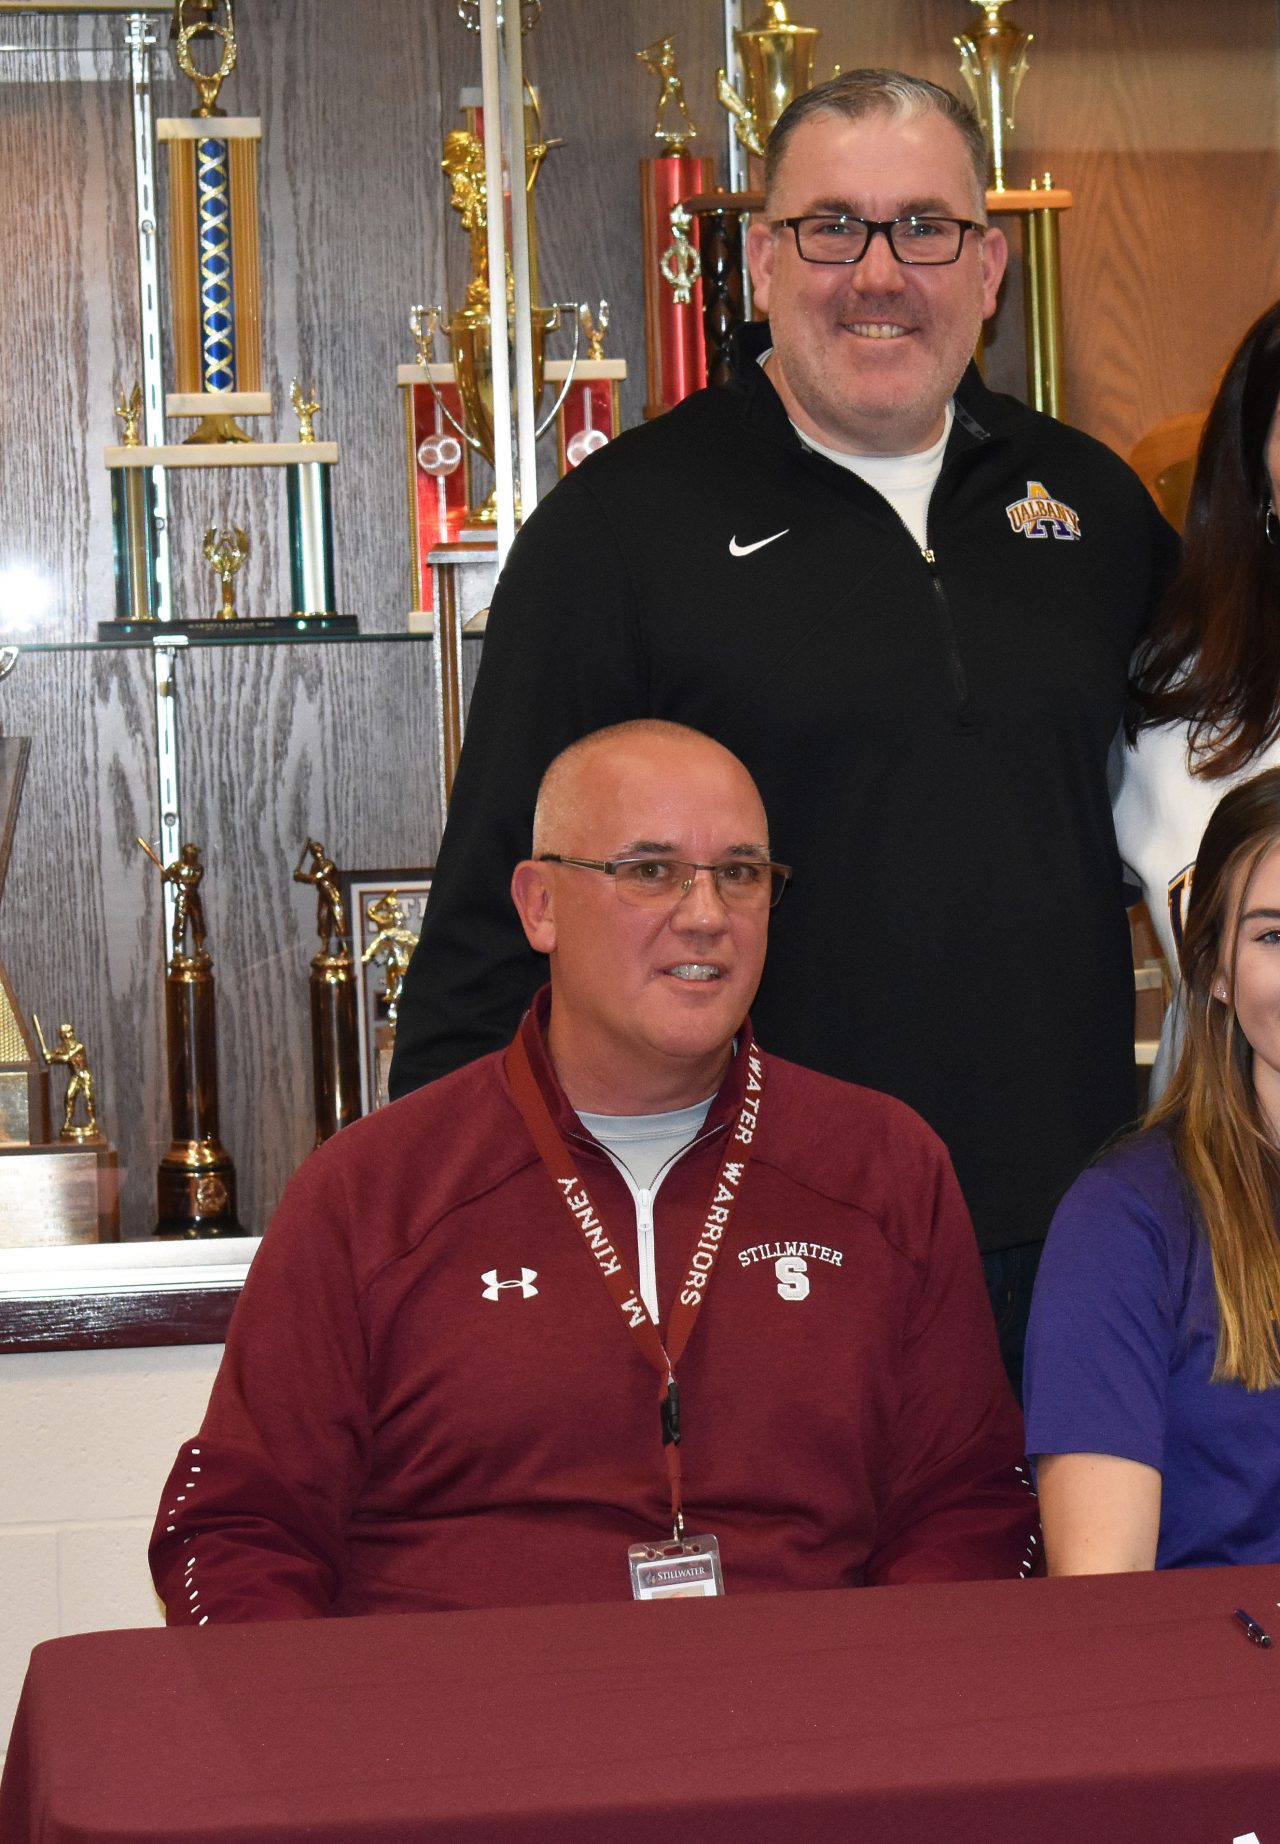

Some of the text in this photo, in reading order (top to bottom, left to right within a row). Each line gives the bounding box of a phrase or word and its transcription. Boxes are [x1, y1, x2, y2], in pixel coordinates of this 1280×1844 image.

[1007, 500, 1079, 534] UALBANY
[556, 1177, 647, 1329] M. KINNEY
[680, 1162, 745, 1307] WARRIORS
[738, 1241, 843, 1267] STILLWATER
[774, 1256, 810, 1301] S
[656, 1566, 706, 1582] STILLWATER
